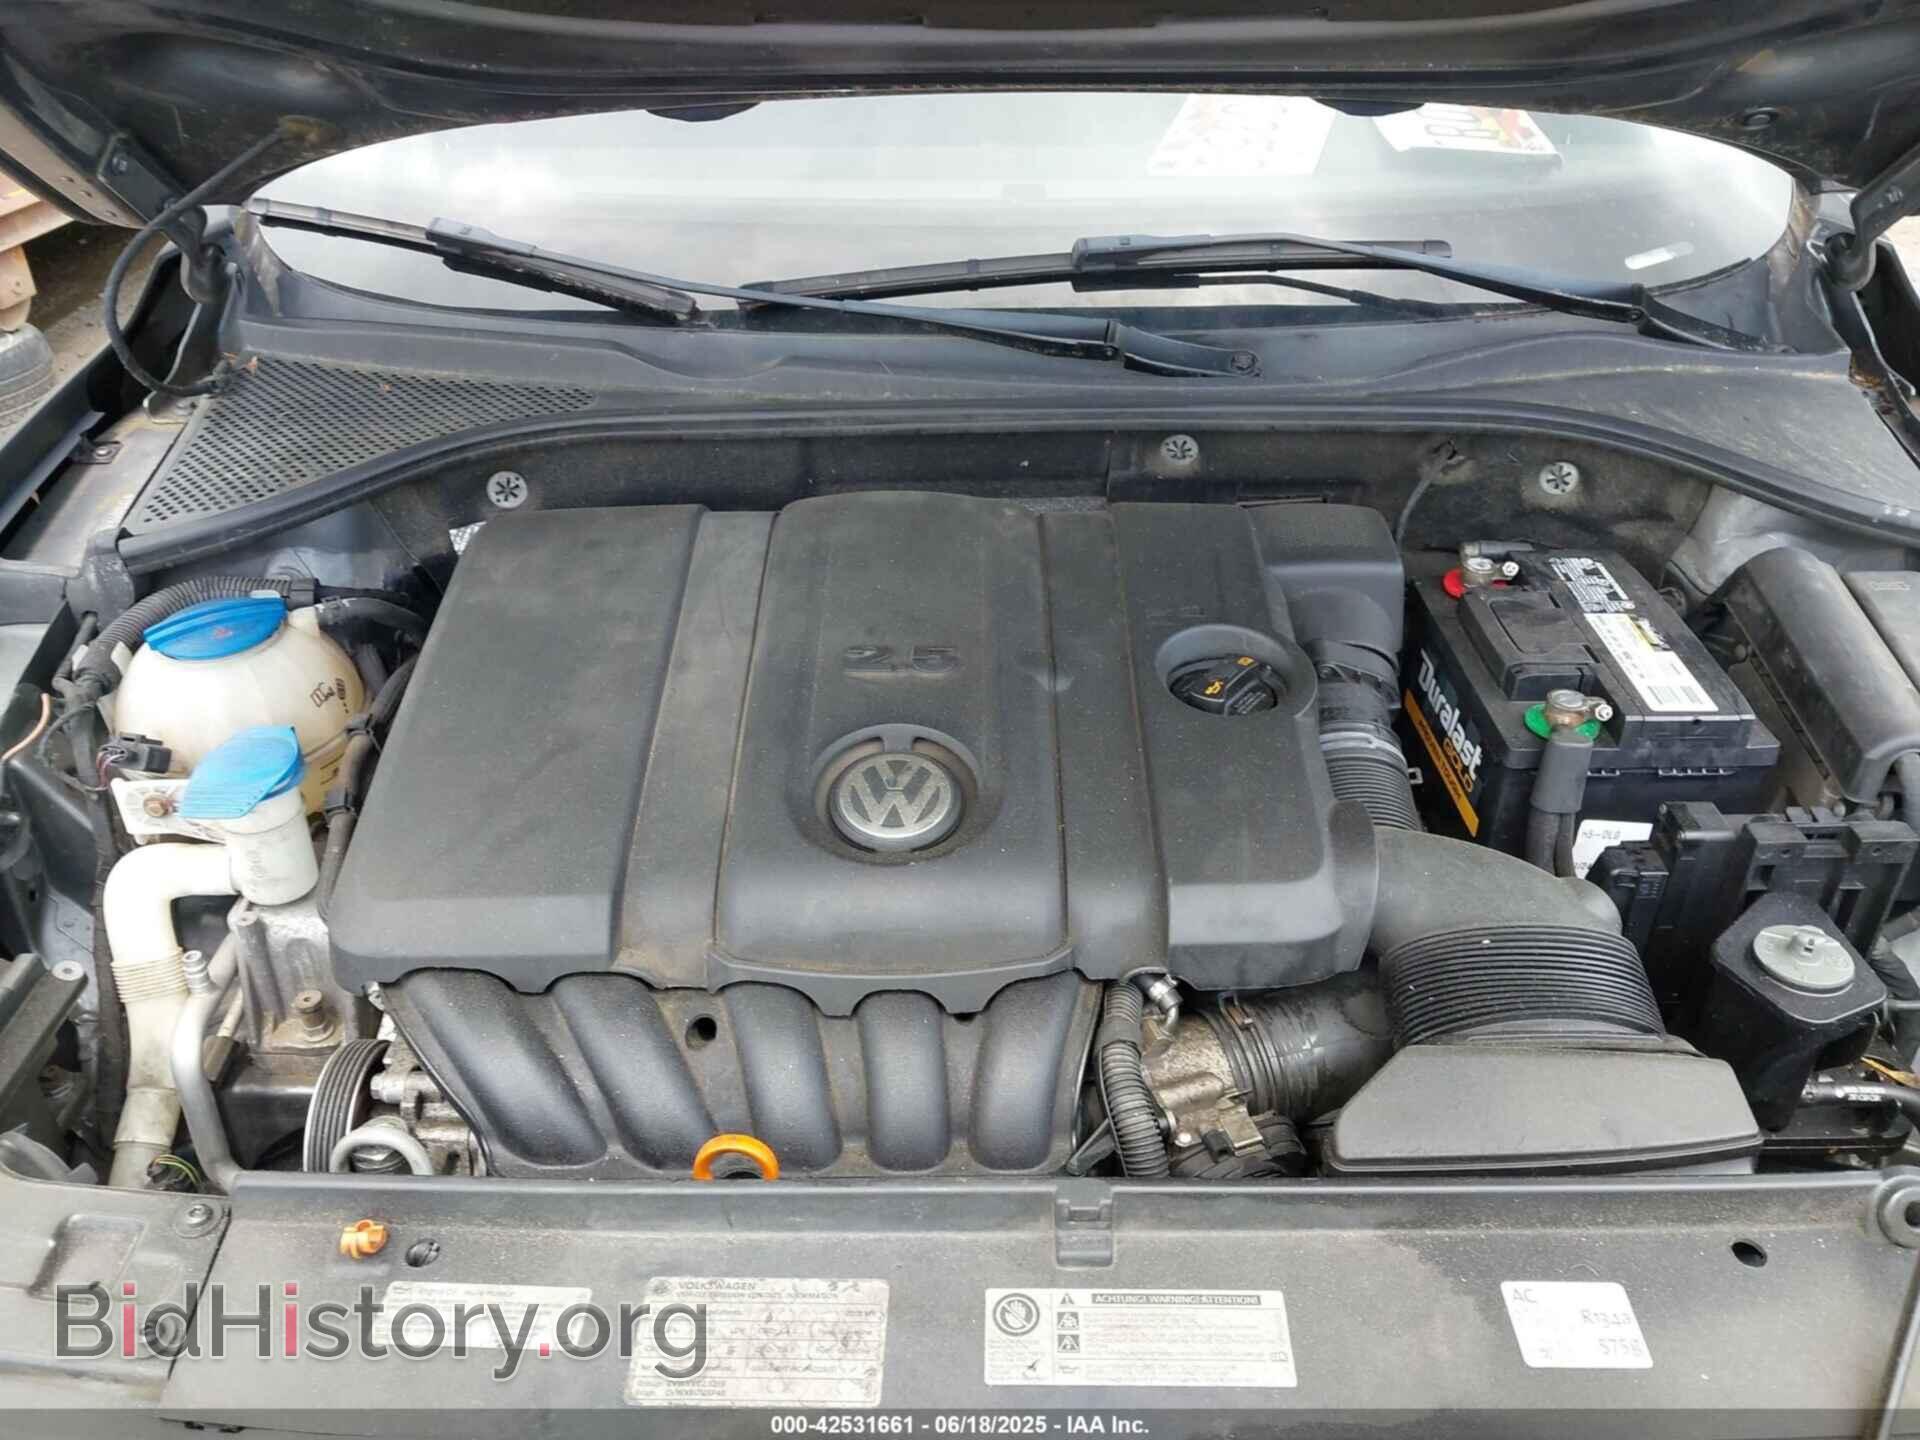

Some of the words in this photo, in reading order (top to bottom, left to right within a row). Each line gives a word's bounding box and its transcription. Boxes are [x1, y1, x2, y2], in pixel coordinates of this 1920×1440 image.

[844, 645, 960, 674] 2.5
[1418, 648, 1483, 781] Duralast
[1443, 737, 1473, 793] GOLD
[678, 1281, 757, 1291] VOLKSWAGEN
[1512, 1288, 1536, 1303] AC
